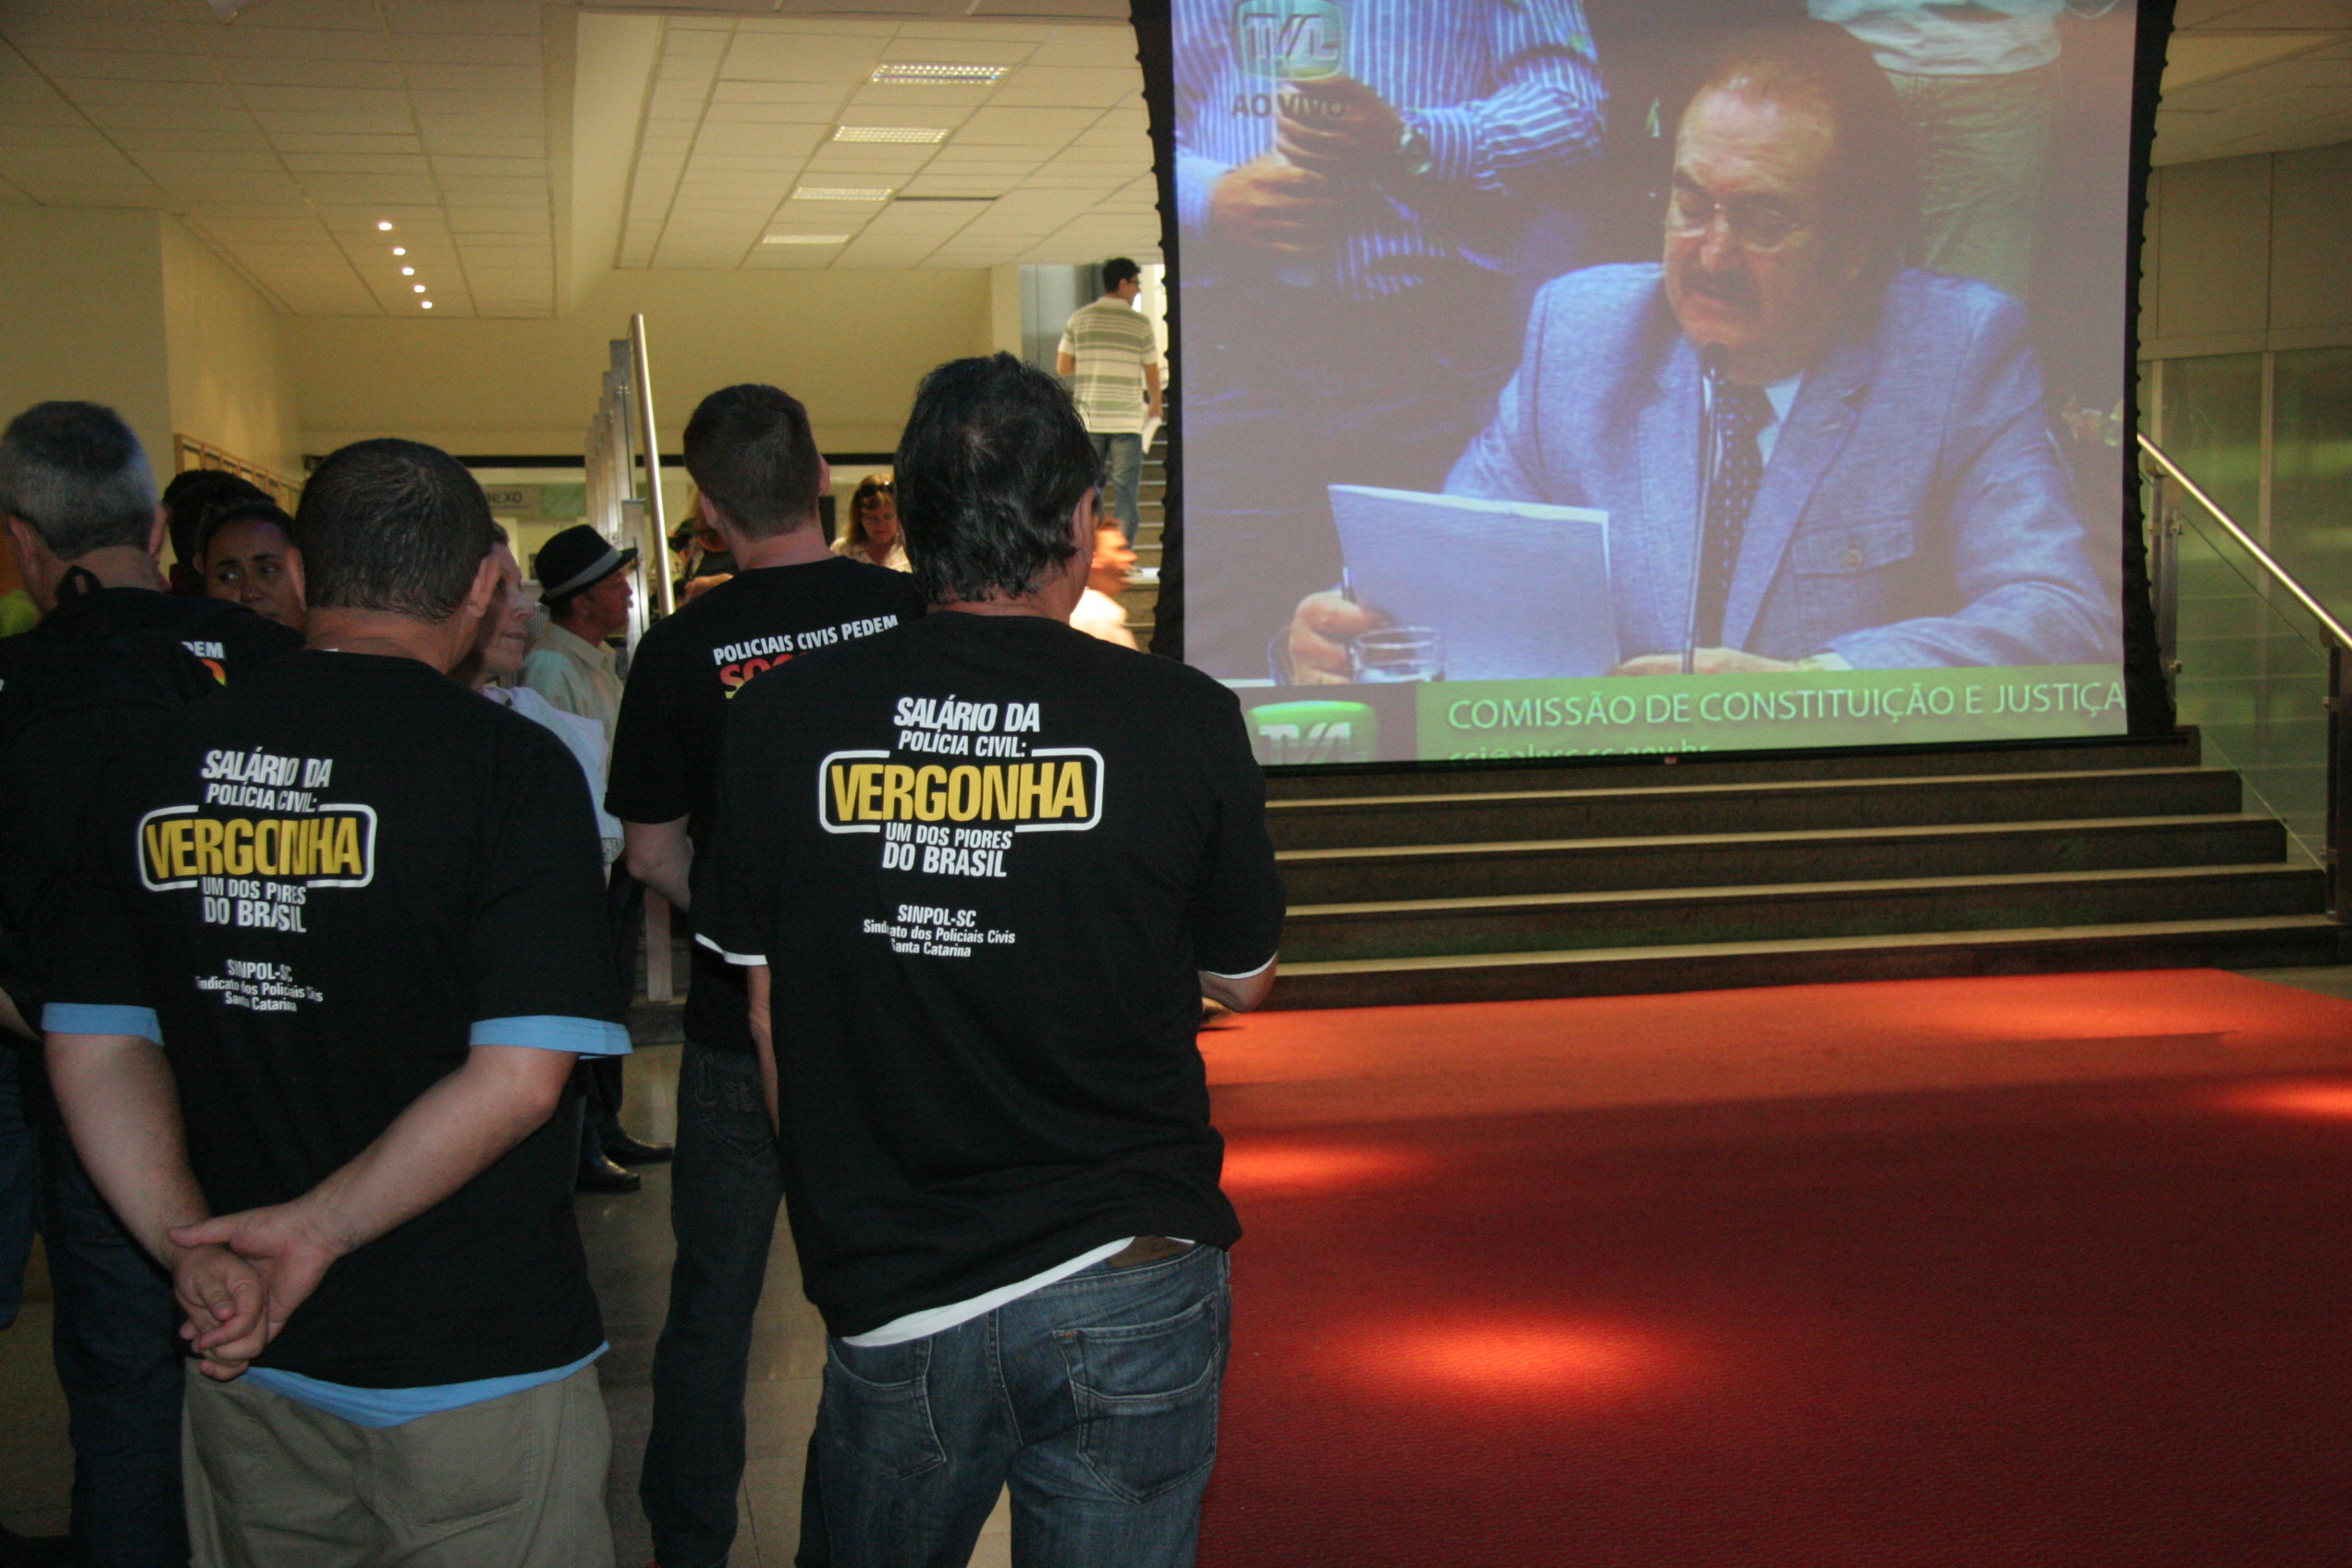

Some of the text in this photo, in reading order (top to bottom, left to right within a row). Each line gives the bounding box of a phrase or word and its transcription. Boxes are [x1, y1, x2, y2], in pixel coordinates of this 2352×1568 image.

[1231, 93, 1272, 118] AO
[713, 614, 899, 666] POLICIAIS CIVIS PEDEM
[894, 694, 1041, 733] SALÁRIO DA
[1448, 681, 2125, 729] COMISSÃO DE CONSTITUIÇÃO E JUSTIÇA
[898, 729, 1026, 758] POLÍCIA CIVIL:
[202, 746, 334, 788] SALÁRIO DA
[205, 781, 276, 811] POLÍCIA
[831, 762, 1087, 821] VERGONHA
[146, 817, 362, 879] VERGONHA
[885, 822, 1012, 849] UM DOS PIORES
[882, 841, 1008, 877] DO BRASIL
[202, 876, 225, 896] UM
[228, 879, 261, 900] DOS
[203, 896, 307, 933] DO BRASIL
[897, 904, 976, 927] SINPOL-SC
[911, 925, 932, 940] dos
[936, 927, 984, 943] Policiais
[987, 930, 1016, 944] Civis
[924, 941, 972, 957] Catarina
[252, 997, 298, 1012] Catarina
